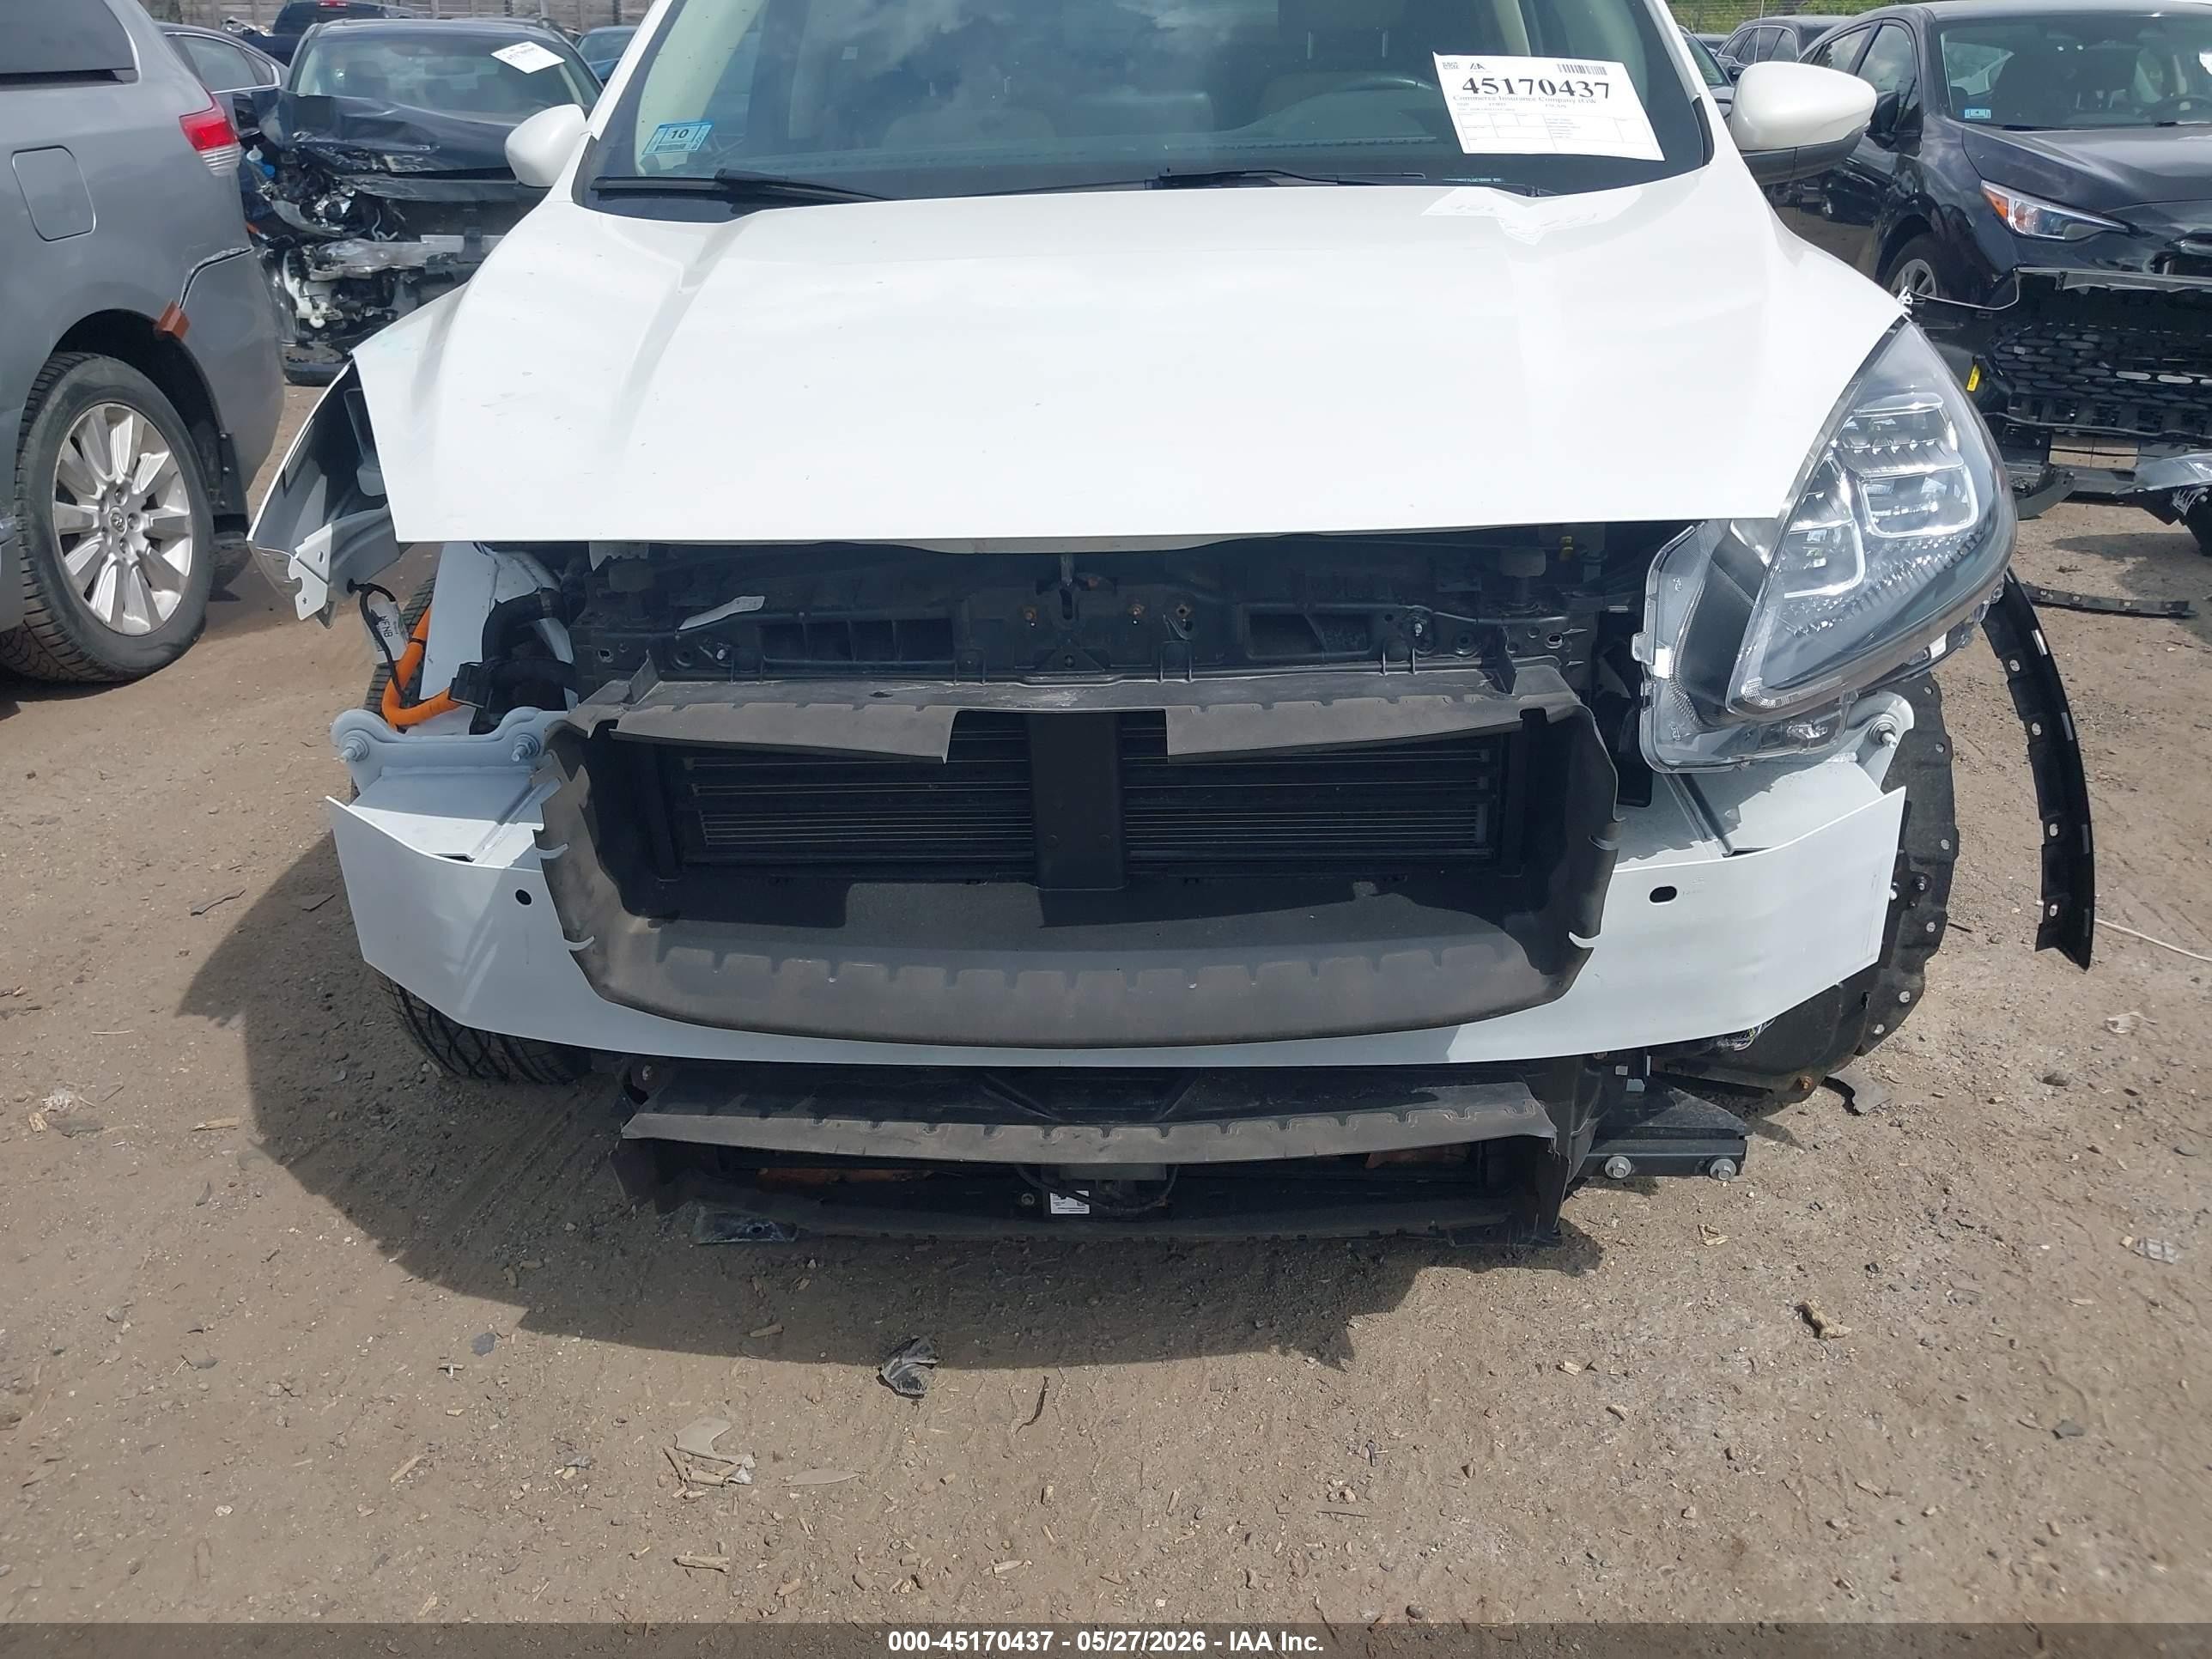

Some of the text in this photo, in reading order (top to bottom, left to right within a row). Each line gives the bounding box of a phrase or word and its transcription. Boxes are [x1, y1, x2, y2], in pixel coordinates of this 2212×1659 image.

[1462, 76, 1610, 100] 45170437
[1498, 94, 1536, 103] Insurance
[1538, 95, 1577, 105] Company
[671, 129, 690, 139] 10
